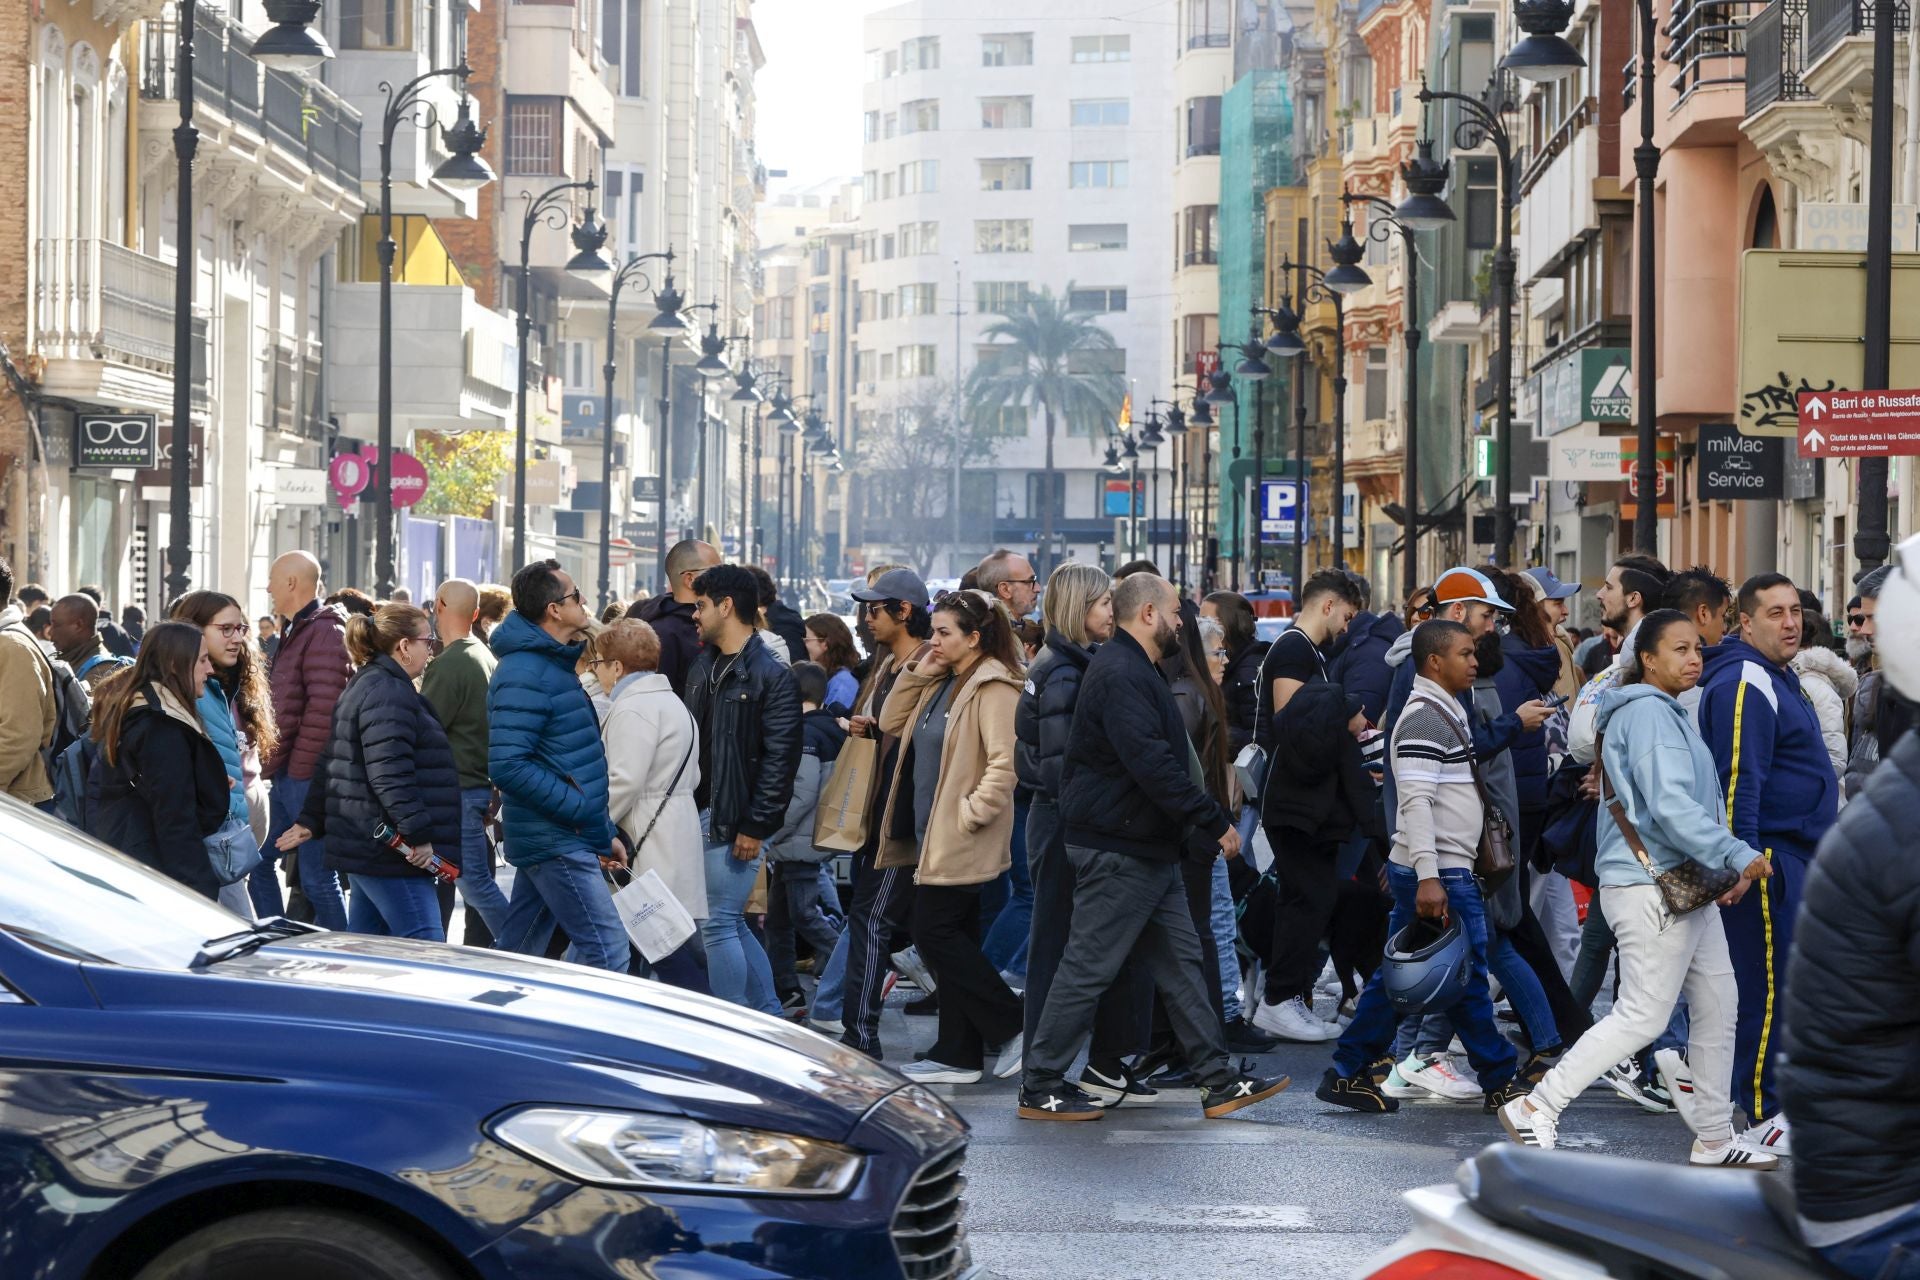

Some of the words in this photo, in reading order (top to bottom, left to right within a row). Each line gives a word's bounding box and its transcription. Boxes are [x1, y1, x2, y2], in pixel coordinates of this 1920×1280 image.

[1831, 396, 1858, 409] Barri
[1861, 396, 1875, 408] de
[1878, 394, 1920, 408] Russafa
[84, 448, 148, 456] HAWKERS
[1708, 436, 1764, 453] miMac
[1708, 472, 1764, 487] Service
[1268, 484, 1296, 519] P
